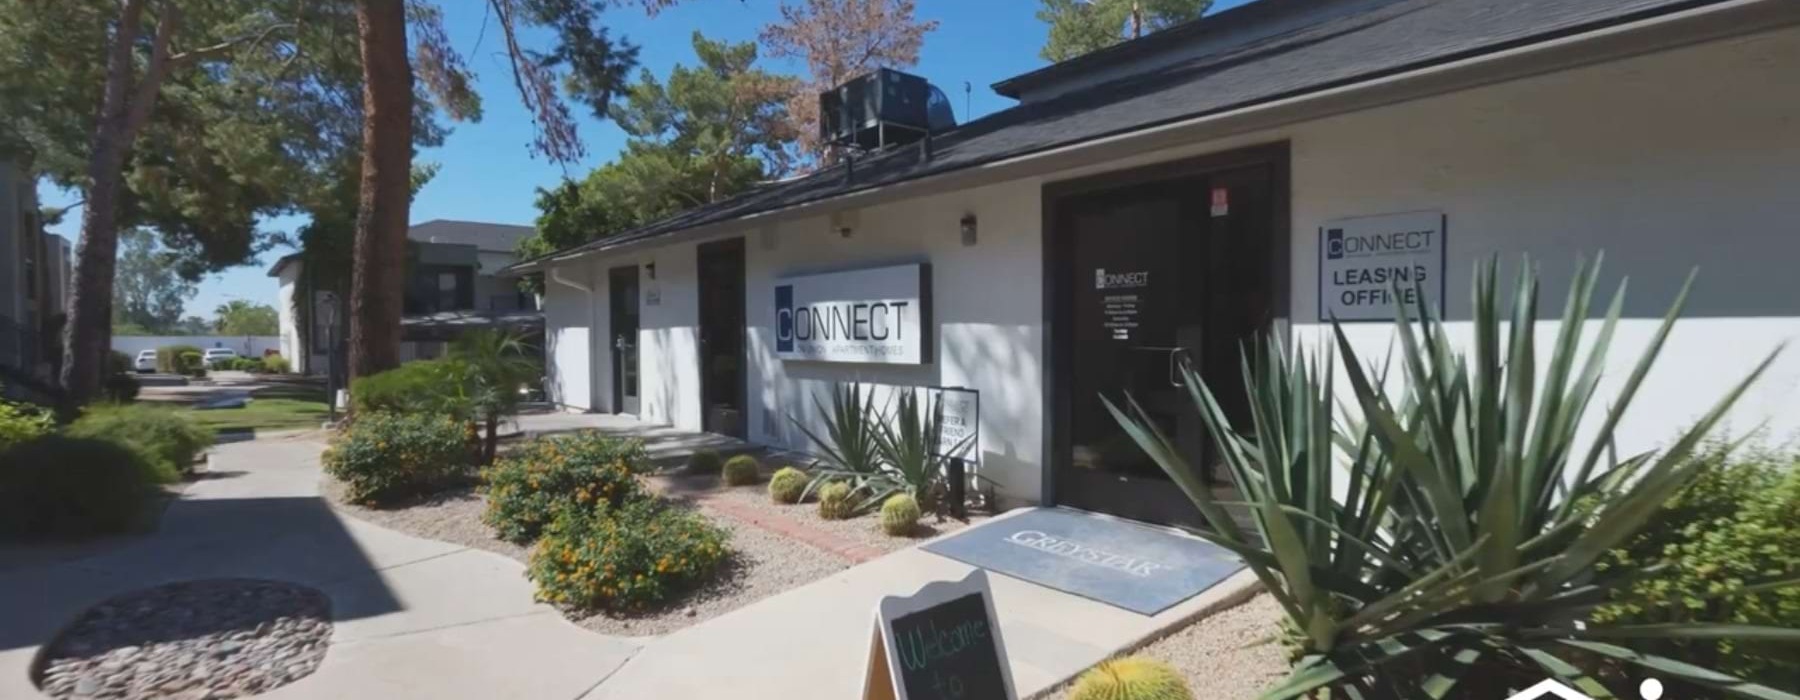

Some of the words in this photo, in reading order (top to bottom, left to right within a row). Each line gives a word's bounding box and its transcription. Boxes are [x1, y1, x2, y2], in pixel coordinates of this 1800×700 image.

[1330, 230, 1435, 255] CONNECT
[1333, 265, 1427, 286] LEASING
[1341, 287, 1416, 306] OFFIE
[776, 301, 909, 341] CONNECT
[1004, 530, 1162, 577] GREYSTAR
[895, 618, 986, 672] Welcome
